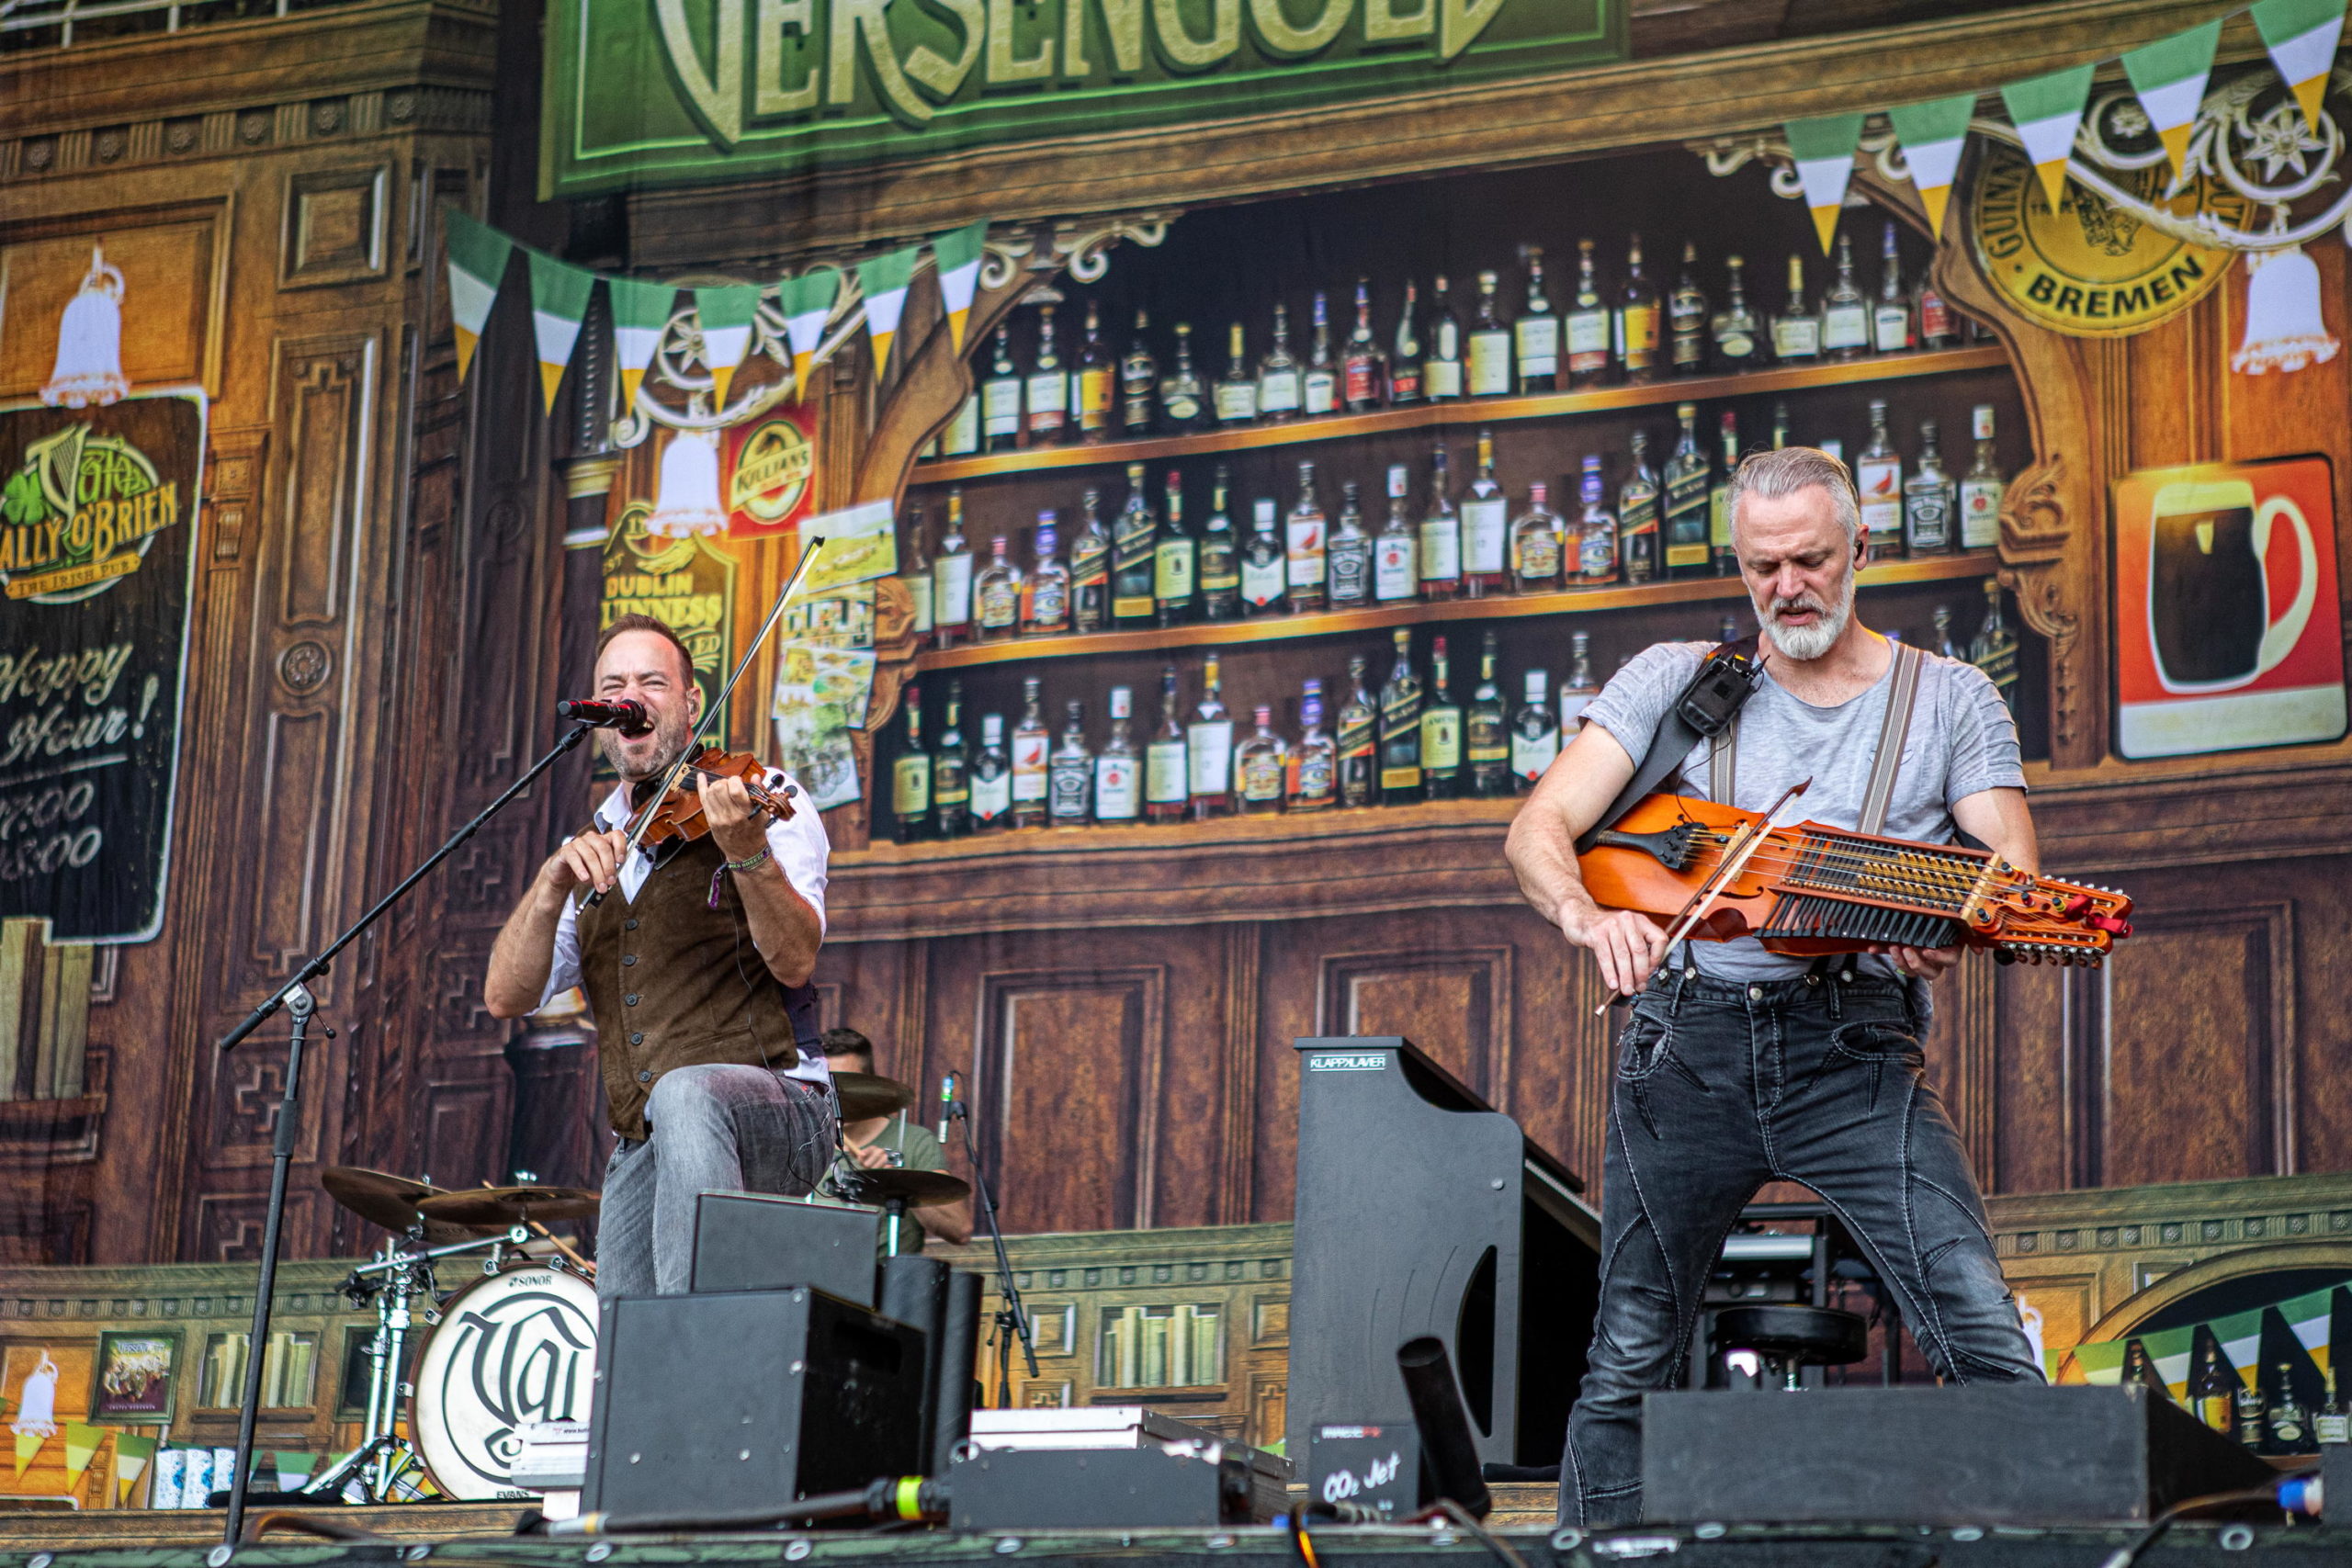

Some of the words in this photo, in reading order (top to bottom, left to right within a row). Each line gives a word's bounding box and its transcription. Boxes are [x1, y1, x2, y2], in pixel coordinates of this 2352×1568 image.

[654, 0, 1503, 143] VERSEN
[2026, 254, 2205, 319] BREMEN
[0, 516, 64, 571] ALLY
[70, 480, 178, 563] O'BRIEN
[52, 569, 94, 588] IRISH
[605, 572, 694, 597] DUBLIN
[601, 594, 723, 630] UINNESS
[0, 641, 134, 706] Happy
[518, 1274, 552, 1287] SONOR
